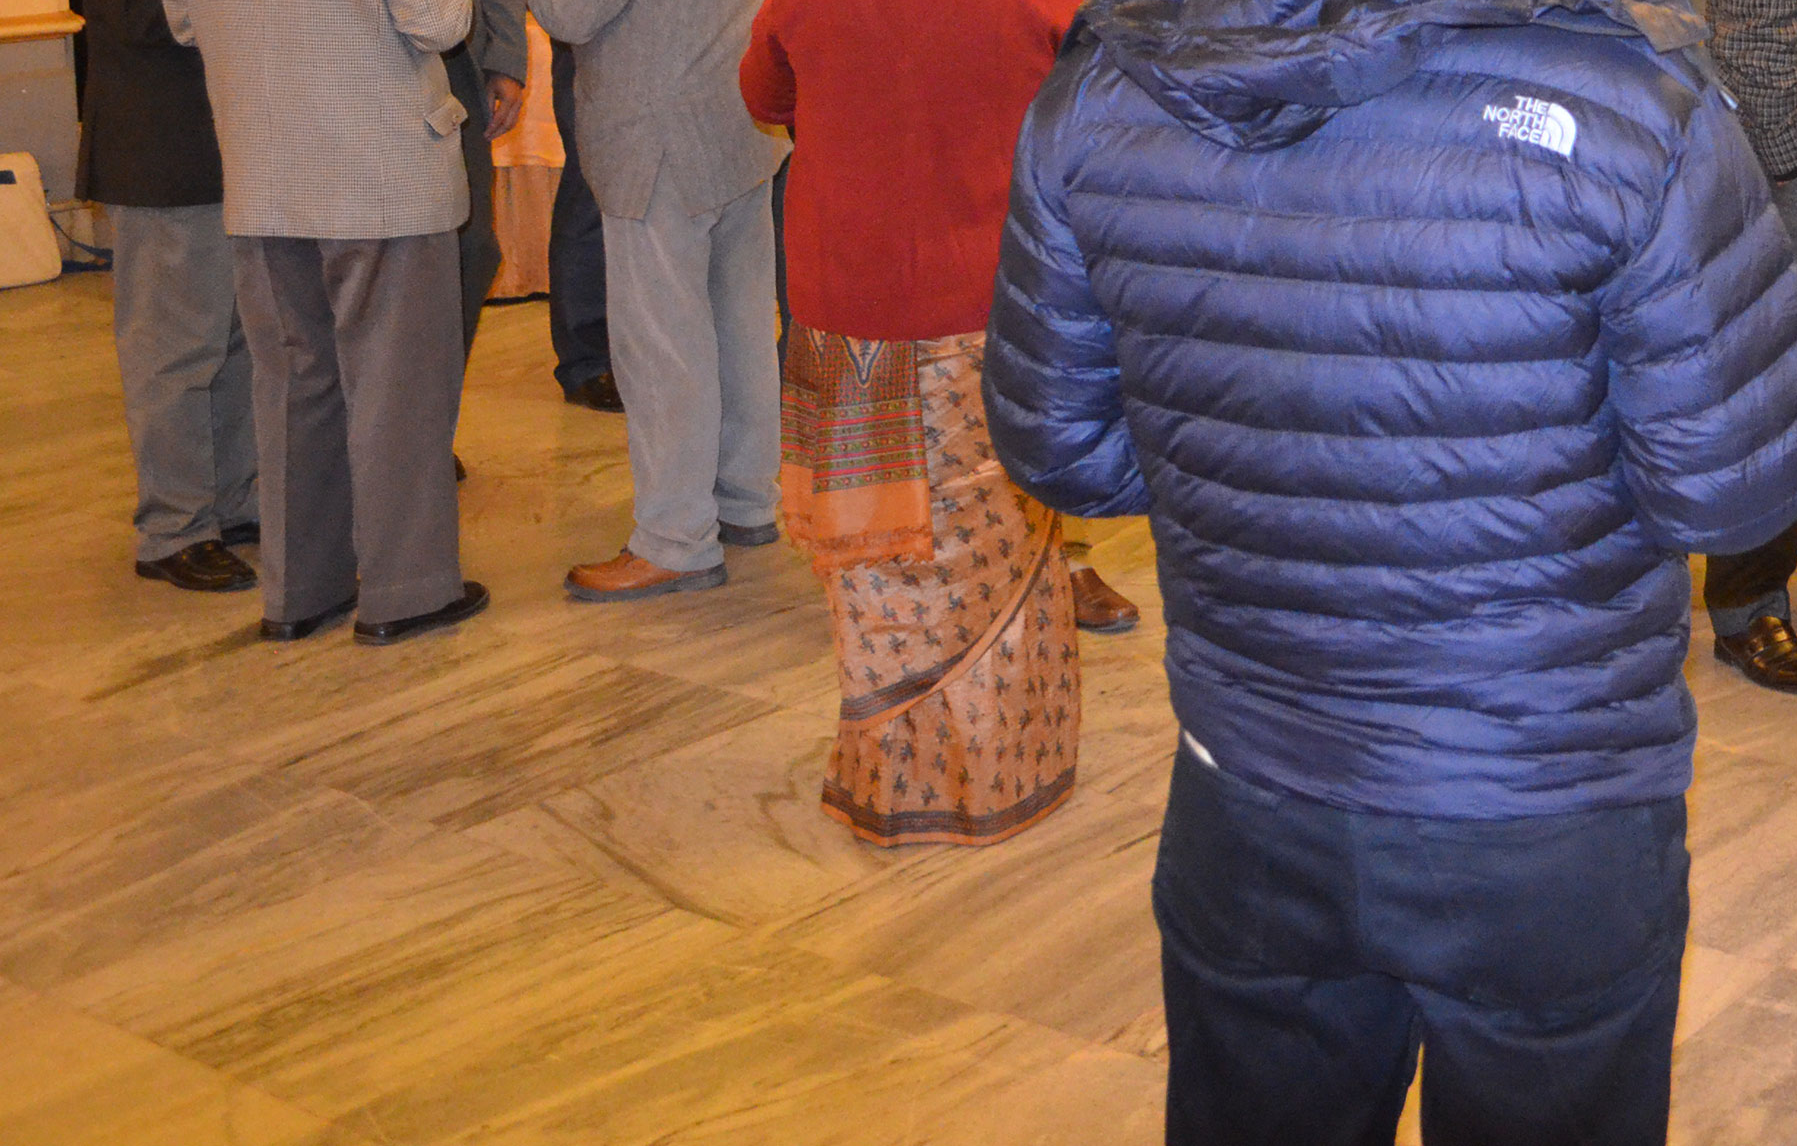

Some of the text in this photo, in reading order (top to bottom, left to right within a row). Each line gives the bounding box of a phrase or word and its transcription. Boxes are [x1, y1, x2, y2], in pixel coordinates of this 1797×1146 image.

[1515, 95, 1550, 115] THE
[1483, 104, 1546, 130] NORTH
[1498, 122, 1543, 144] FACE
